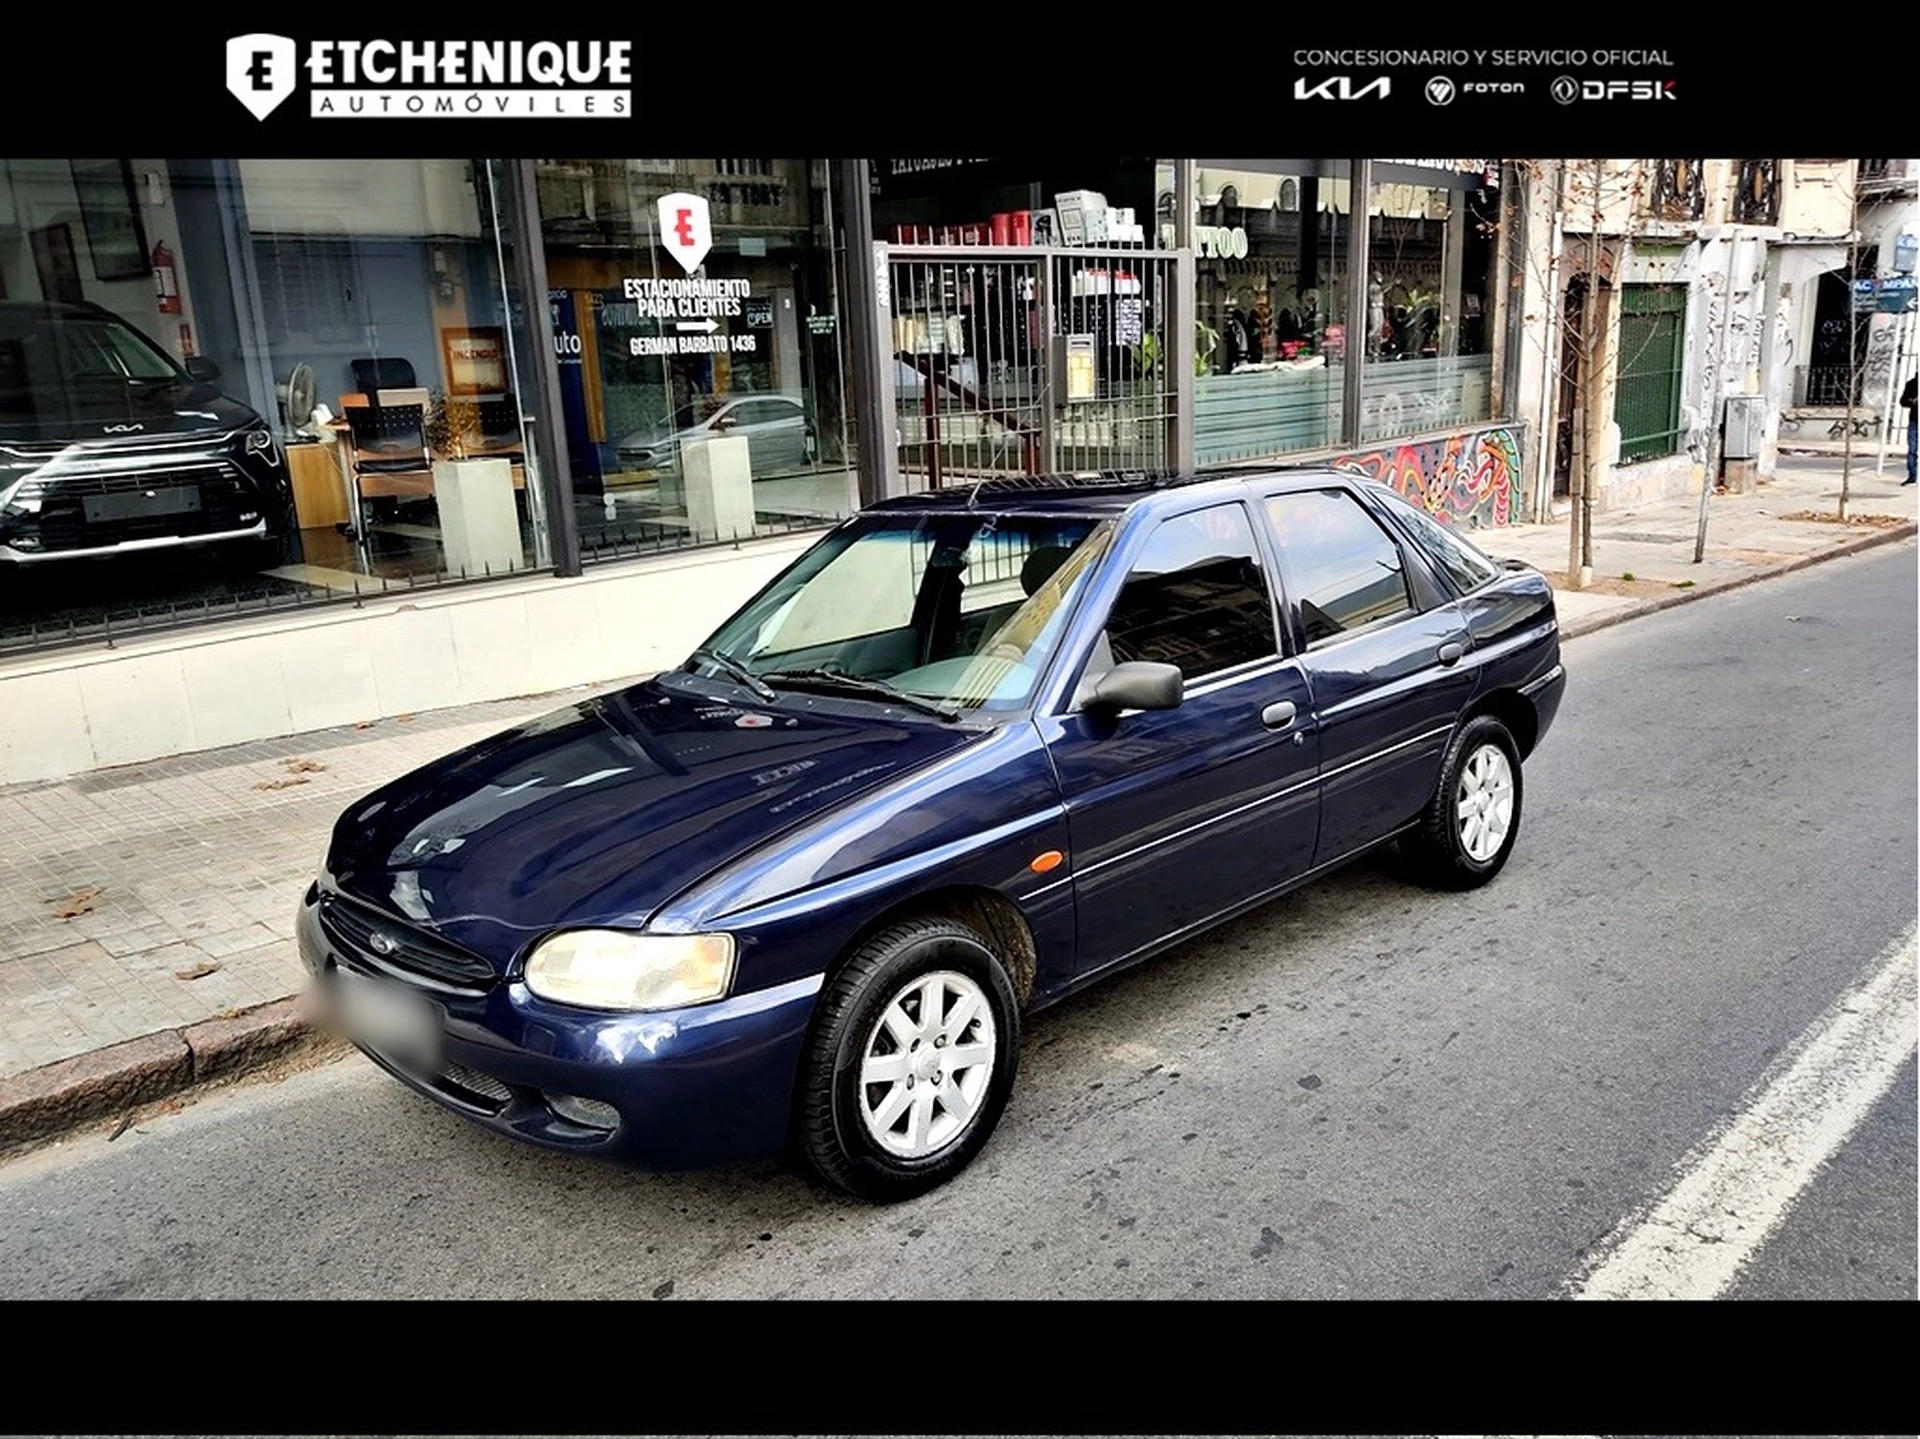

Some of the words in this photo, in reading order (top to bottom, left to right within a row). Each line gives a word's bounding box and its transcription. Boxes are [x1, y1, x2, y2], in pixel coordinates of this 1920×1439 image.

[623, 278, 750, 299] ESTACIONAMIENTO
[638, 298, 677, 317] PARA
[678, 298, 741, 317] CLIENTES
[630, 337, 677, 356] GERMAN
[678, 335, 728, 354] BARBATO
[729, 335, 756, 352] 1436
